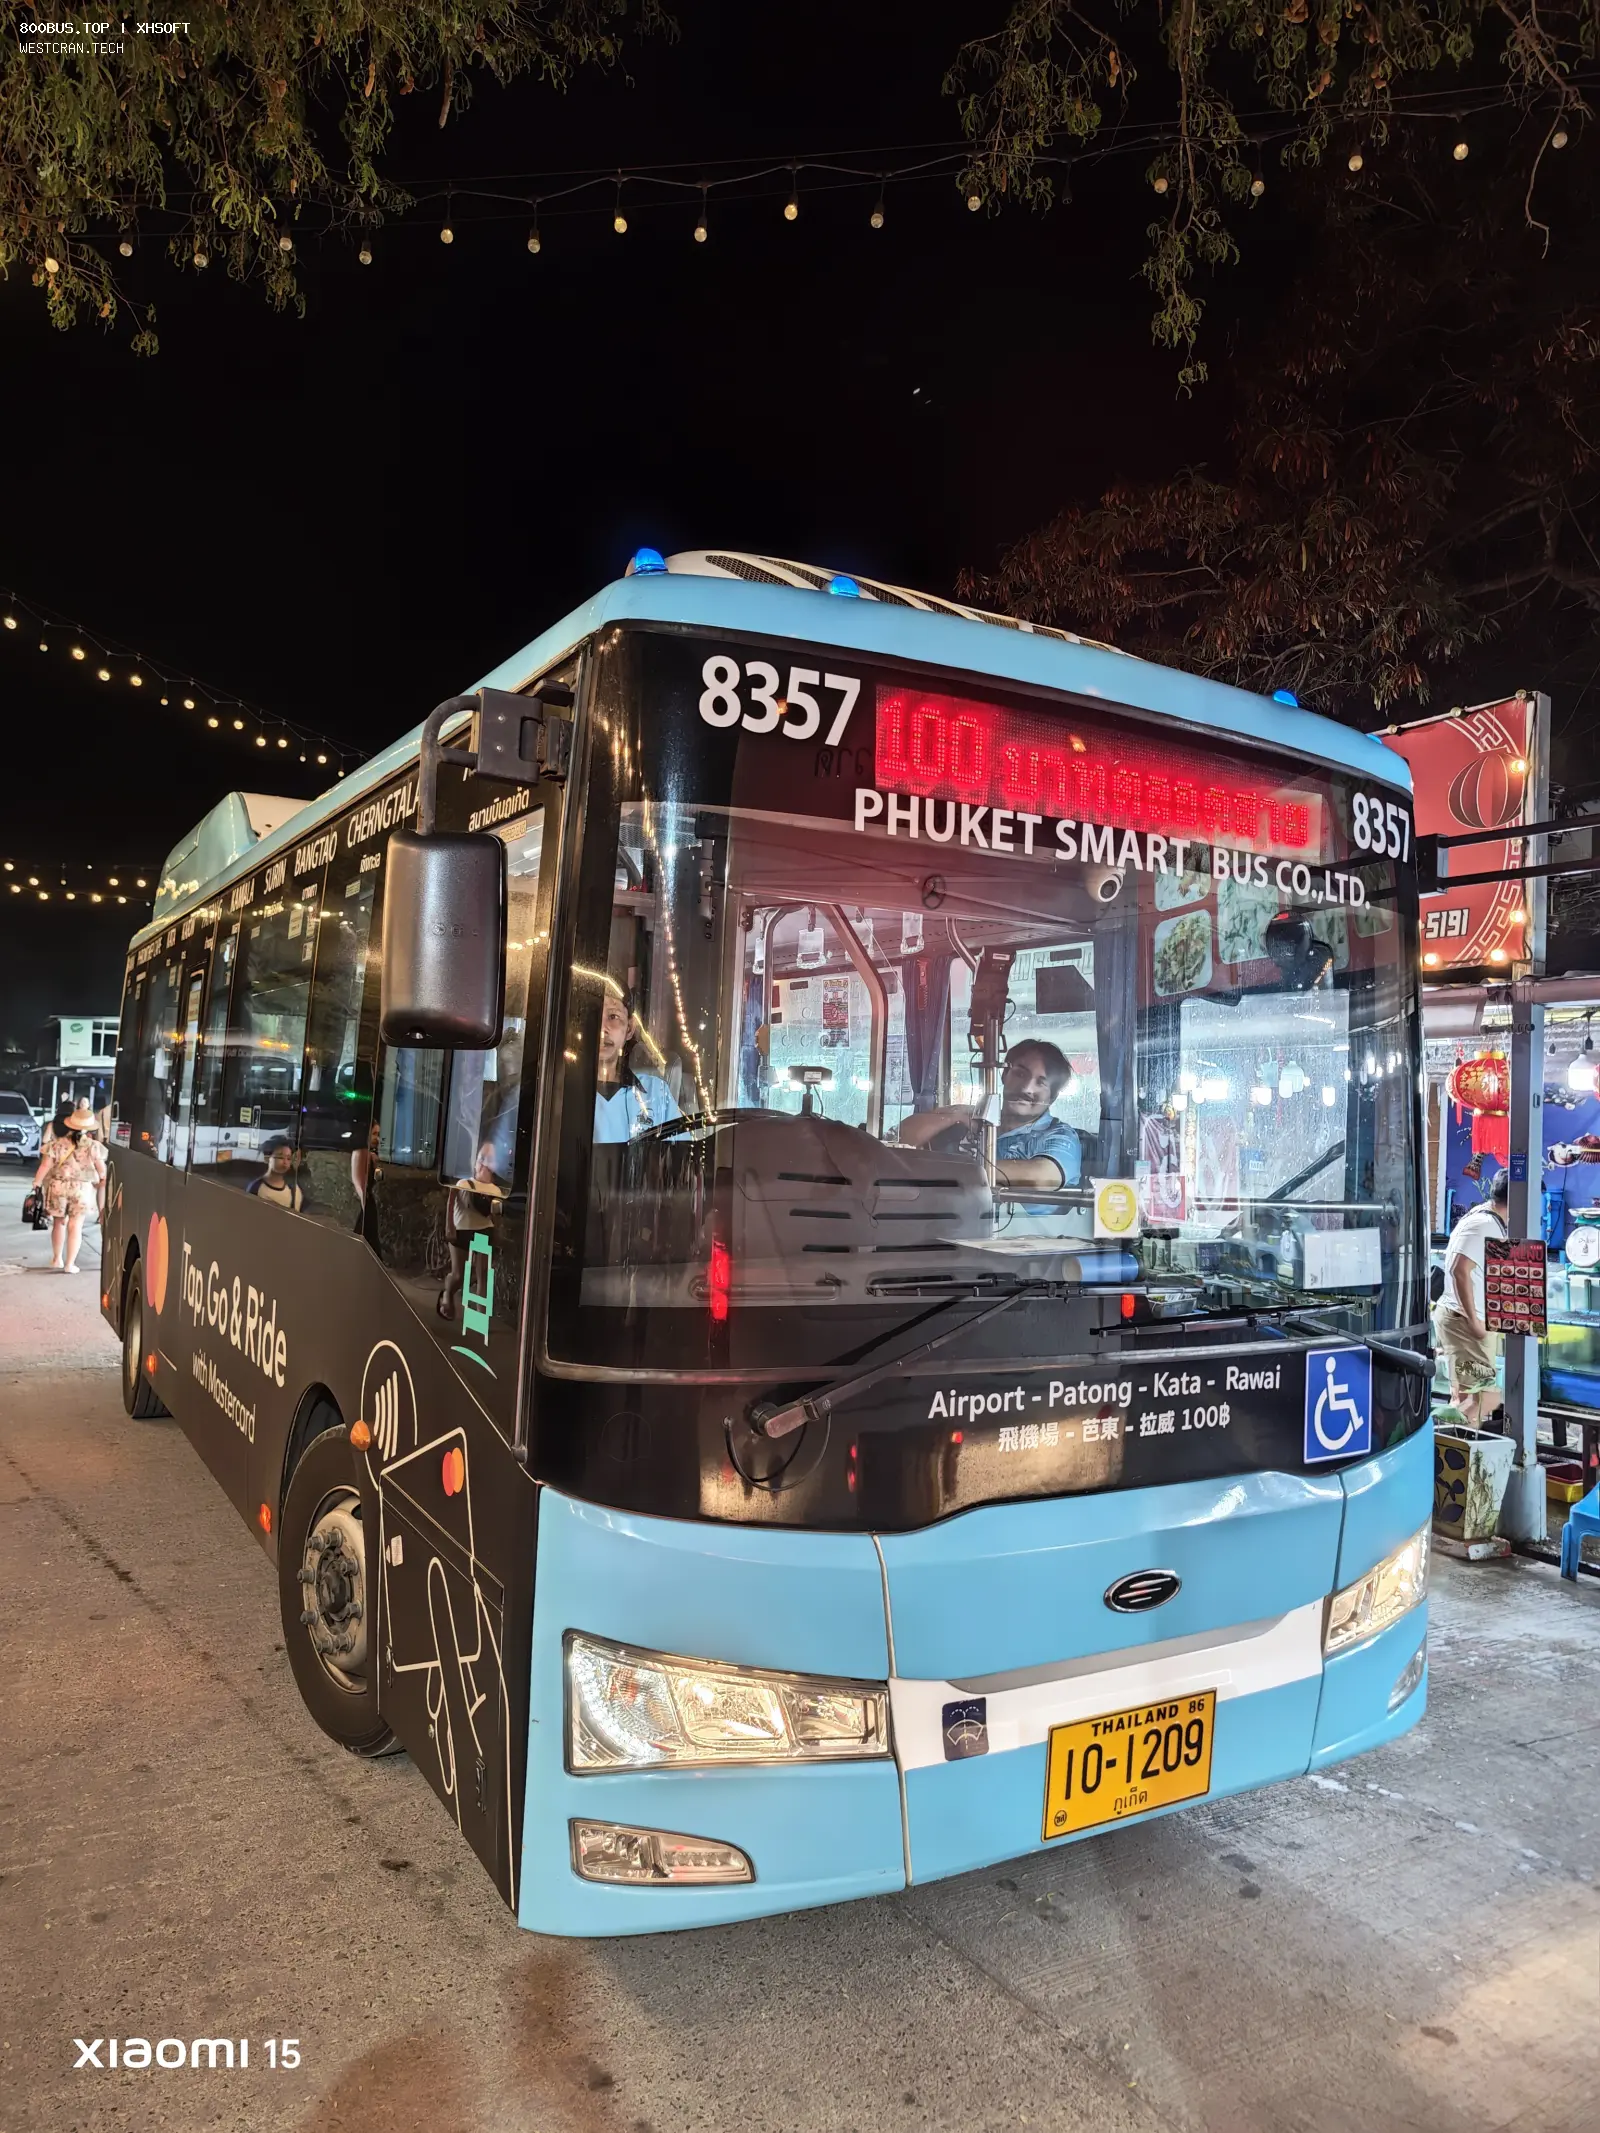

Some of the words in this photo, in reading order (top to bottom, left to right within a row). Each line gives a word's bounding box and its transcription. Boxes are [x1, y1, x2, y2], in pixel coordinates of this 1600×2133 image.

[698, 654, 861, 747] 8357
[882, 698, 984, 786] 100
[294, 831, 338, 877] BANGTAO
[854, 787, 1035, 857] PHUKET
[1055, 818, 1190, 879] SMART
[1213, 847, 1269, 888] BUS
[1352, 792, 1410, 864] 8357
[182, 1241, 205, 1327] Tap,
[207, 1260, 228, 1336] Go
[230, 1275, 242, 1347] &
[245, 1284, 288, 1388] Ride
[192, 1349, 208, 1390] with
[208, 1367, 256, 1445] Mastercard
[928, 1383, 1026, 1422] Airport
[1048, 1375, 1133, 1412] Patong
[1153, 1371, 1202, 1398] Kata
[1226, 1363, 1282, 1392] Rawai
[998, 1421, 1059, 1452] 飛機場
[1081, 1416, 1120, 1443] 芭東
[1139, 1409, 1176, 1438] 拉威
[1091, 1705, 1180, 1737] THAILAND
[1188, 1698, 1205, 1714] 86
[1064, 1717, 1205, 1800] 10-1209
[1113, 1786, 1148, 1815] ภูเก็ต
